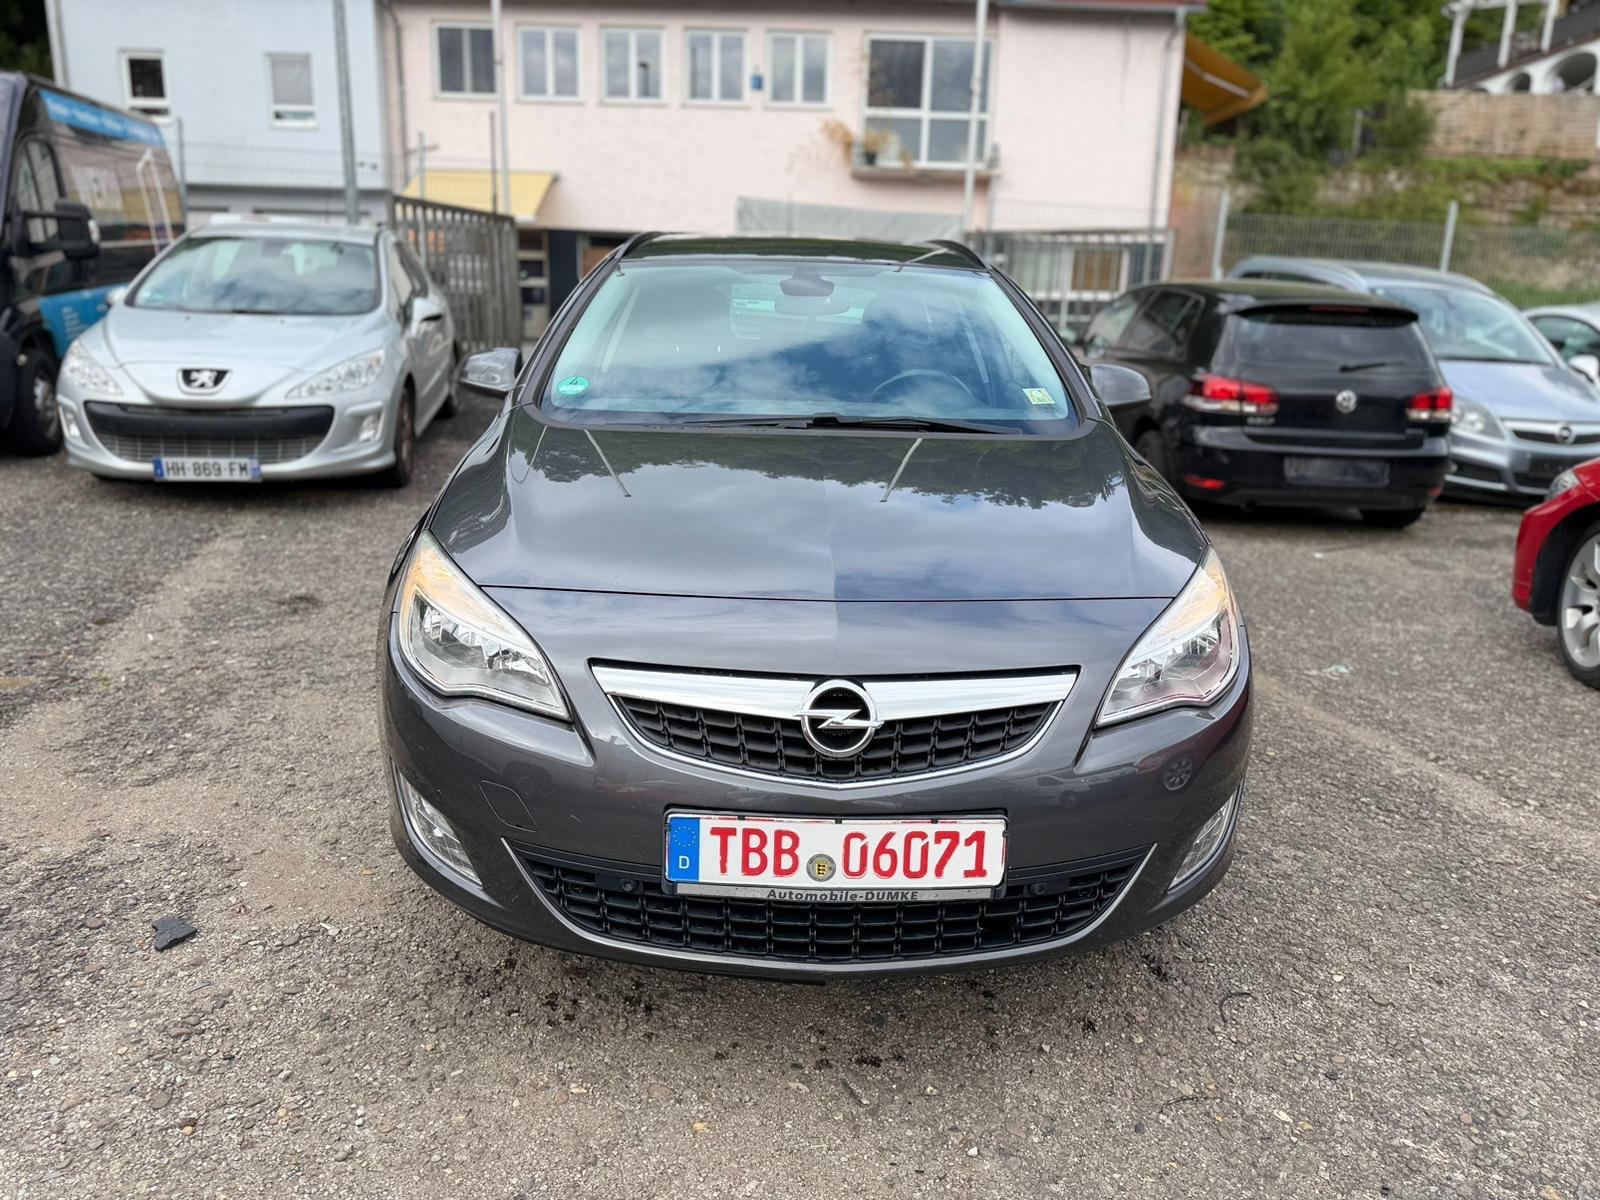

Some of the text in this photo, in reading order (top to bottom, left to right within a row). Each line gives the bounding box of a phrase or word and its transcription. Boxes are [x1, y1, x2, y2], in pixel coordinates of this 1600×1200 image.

[710, 827, 800, 877] TBB
[841, 830, 988, 879] 06071
[679, 856, 690, 869] D
[767, 889, 919, 901] Automobile-DUMKE
